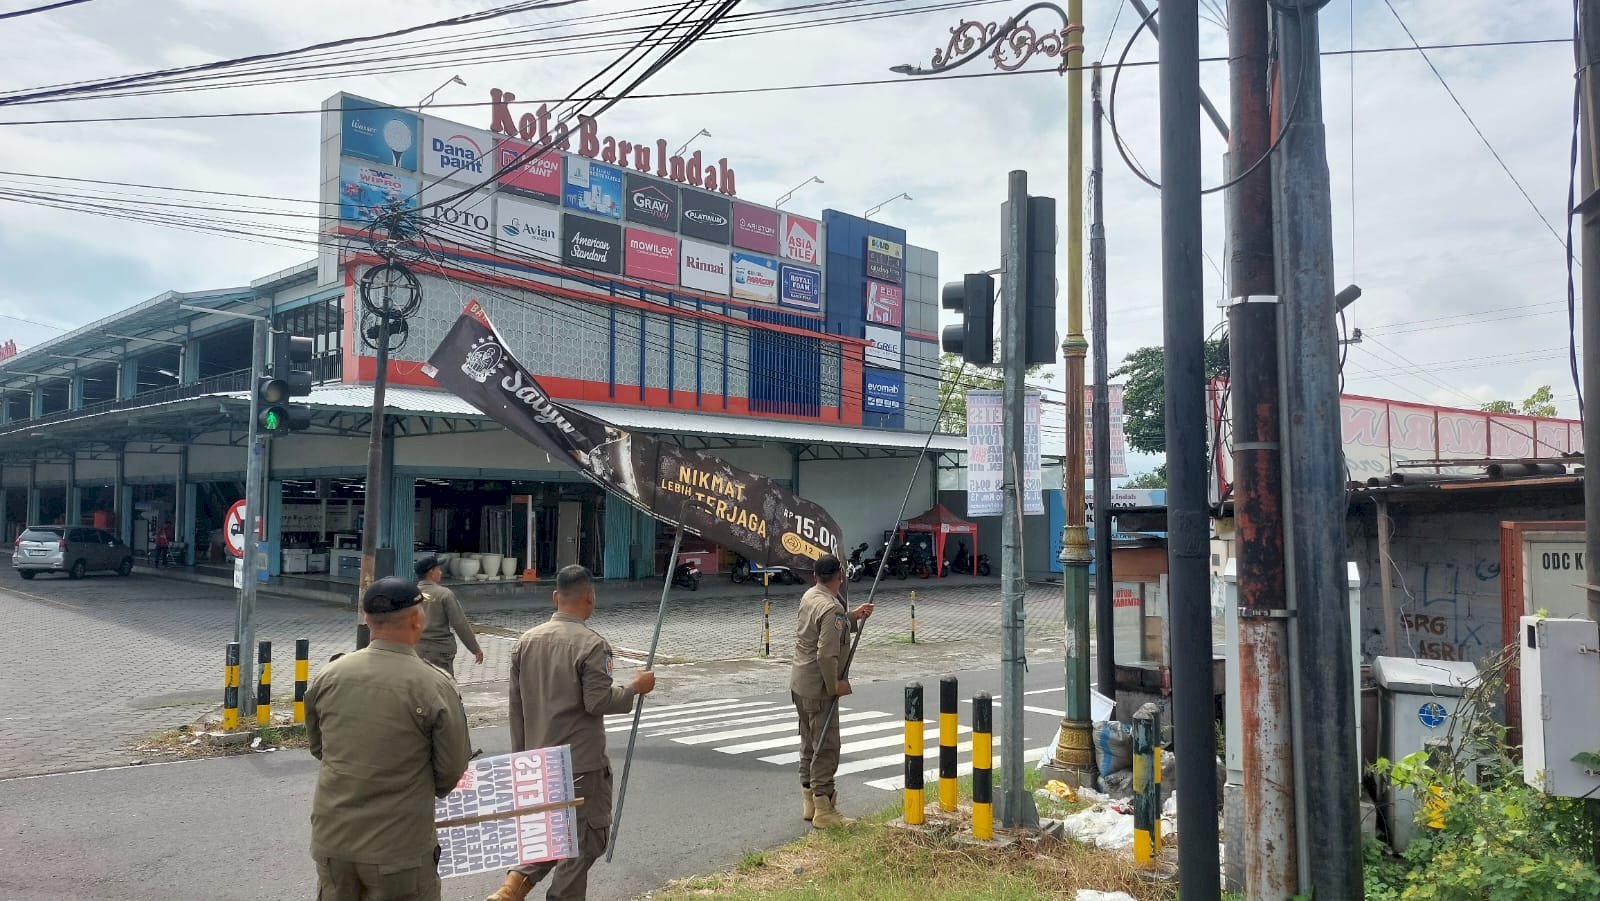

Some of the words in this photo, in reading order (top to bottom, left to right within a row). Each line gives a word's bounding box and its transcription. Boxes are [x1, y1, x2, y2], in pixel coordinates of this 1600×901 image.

[432, 138, 475, 160] Dana
[490, 87, 570, 150] Kota
[577, 114, 651, 172] Baru
[656, 139, 737, 196] Indah
[440, 154, 483, 173] paint
[524, 164, 553, 178] PAINT
[360, 173, 402, 189] WIPRO
[633, 192, 669, 213] GRAVI
[431, 205, 489, 231] TOTO
[689, 212, 722, 224] PLATINUM
[522, 223, 555, 239] Avian
[746, 222, 775, 234] ARISTON
[571, 231, 611, 250] American
[788, 235, 812, 250] ASIA
[570, 244, 608, 263] Standard
[788, 246, 811, 260] TILE
[686, 255, 724, 274] Rinnai
[790, 274, 812, 285] ROYAL
[792, 282, 810, 291] FOAM
[876, 341, 898, 353] GREE
[867, 382, 899, 394] evomab
[661, 478, 692, 496] LEBIH
[679, 465, 745, 502] NIKMAT
[783, 508, 794, 518] RP
[804, 544, 814, 554] 12
[1542, 552, 1570, 570] ODC
[1400, 613, 1446, 636] SRG
